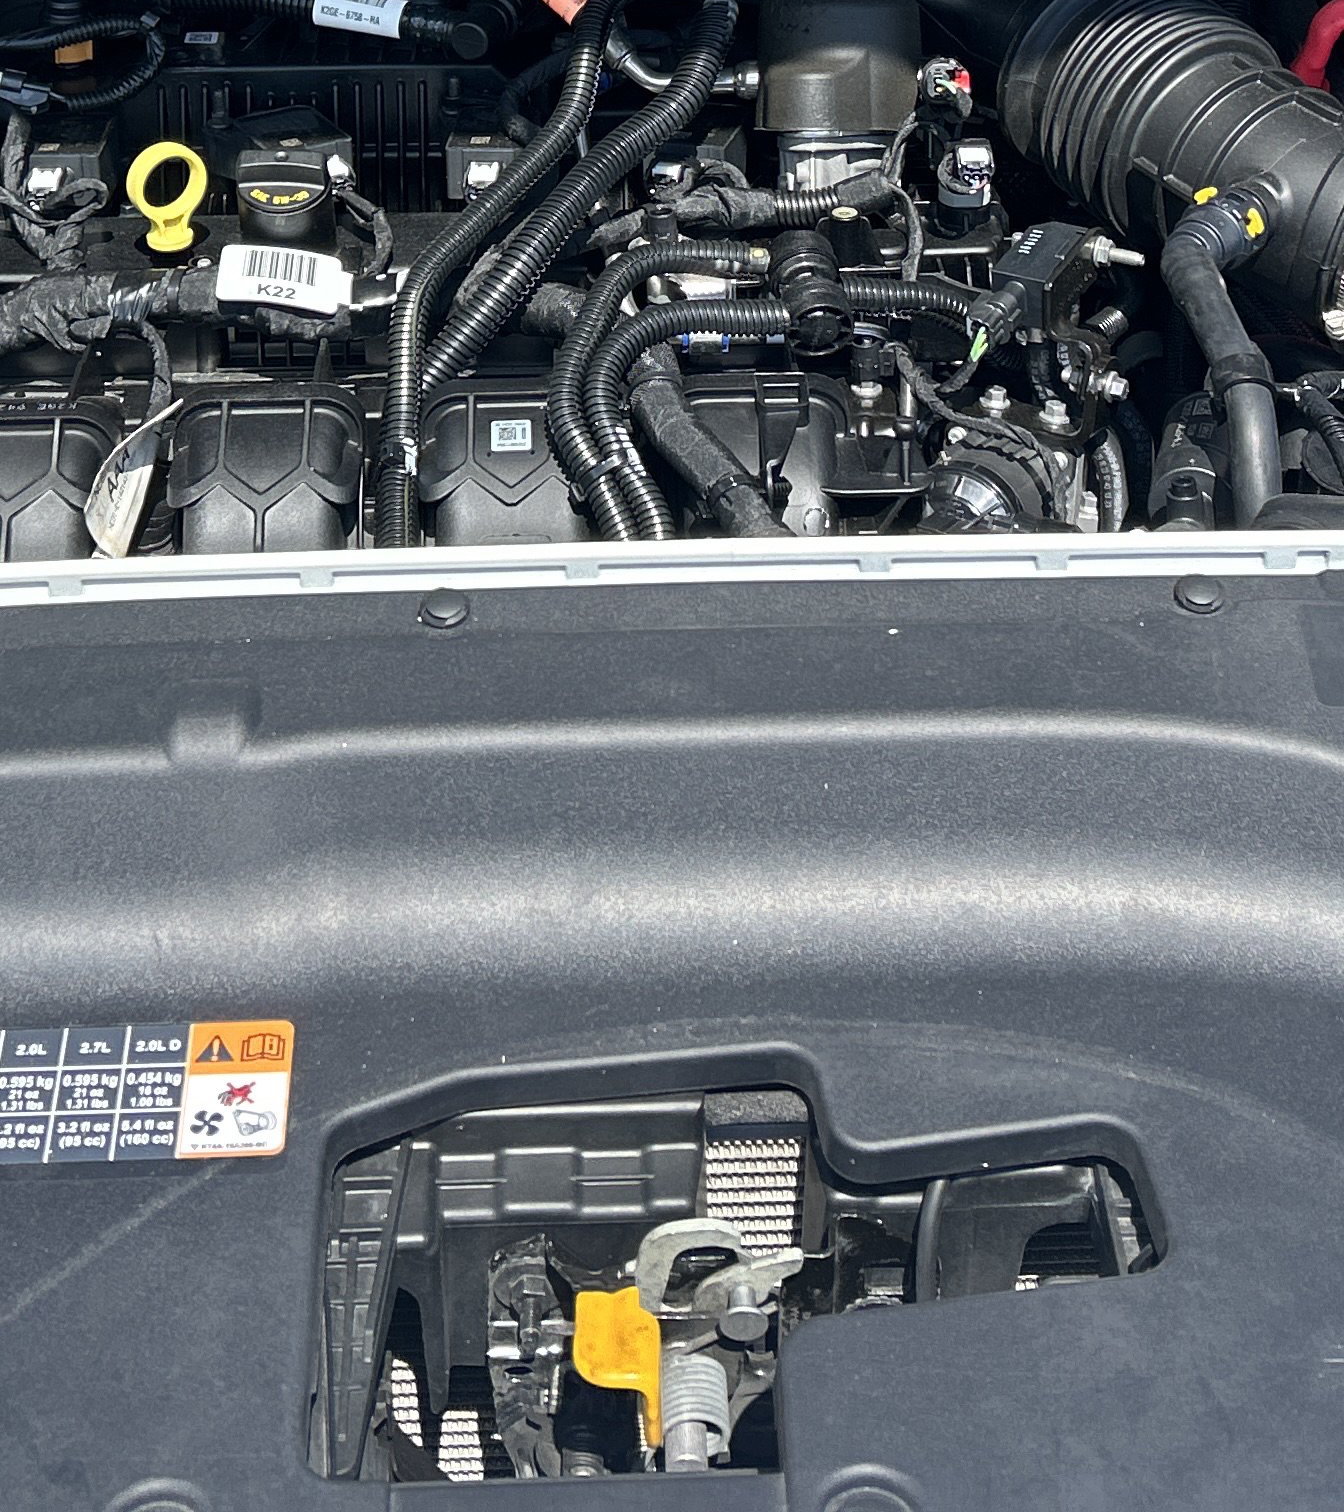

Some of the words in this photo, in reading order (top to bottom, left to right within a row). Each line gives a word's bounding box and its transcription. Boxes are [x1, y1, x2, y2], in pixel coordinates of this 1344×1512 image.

[257, 284, 296, 299] K22
[15, 1044, 47, 1056] 2.0L
[79, 1042, 111, 1054] 2.7L
[135, 1040, 166, 1052] 2.0L
[36, 1075, 54, 1090] kg
[101, 1074, 119, 1088] kg
[164, 1072, 182, 1086] kg
[8, 1089, 22, 1100] 21
[72, 1087, 87, 1098] 21
